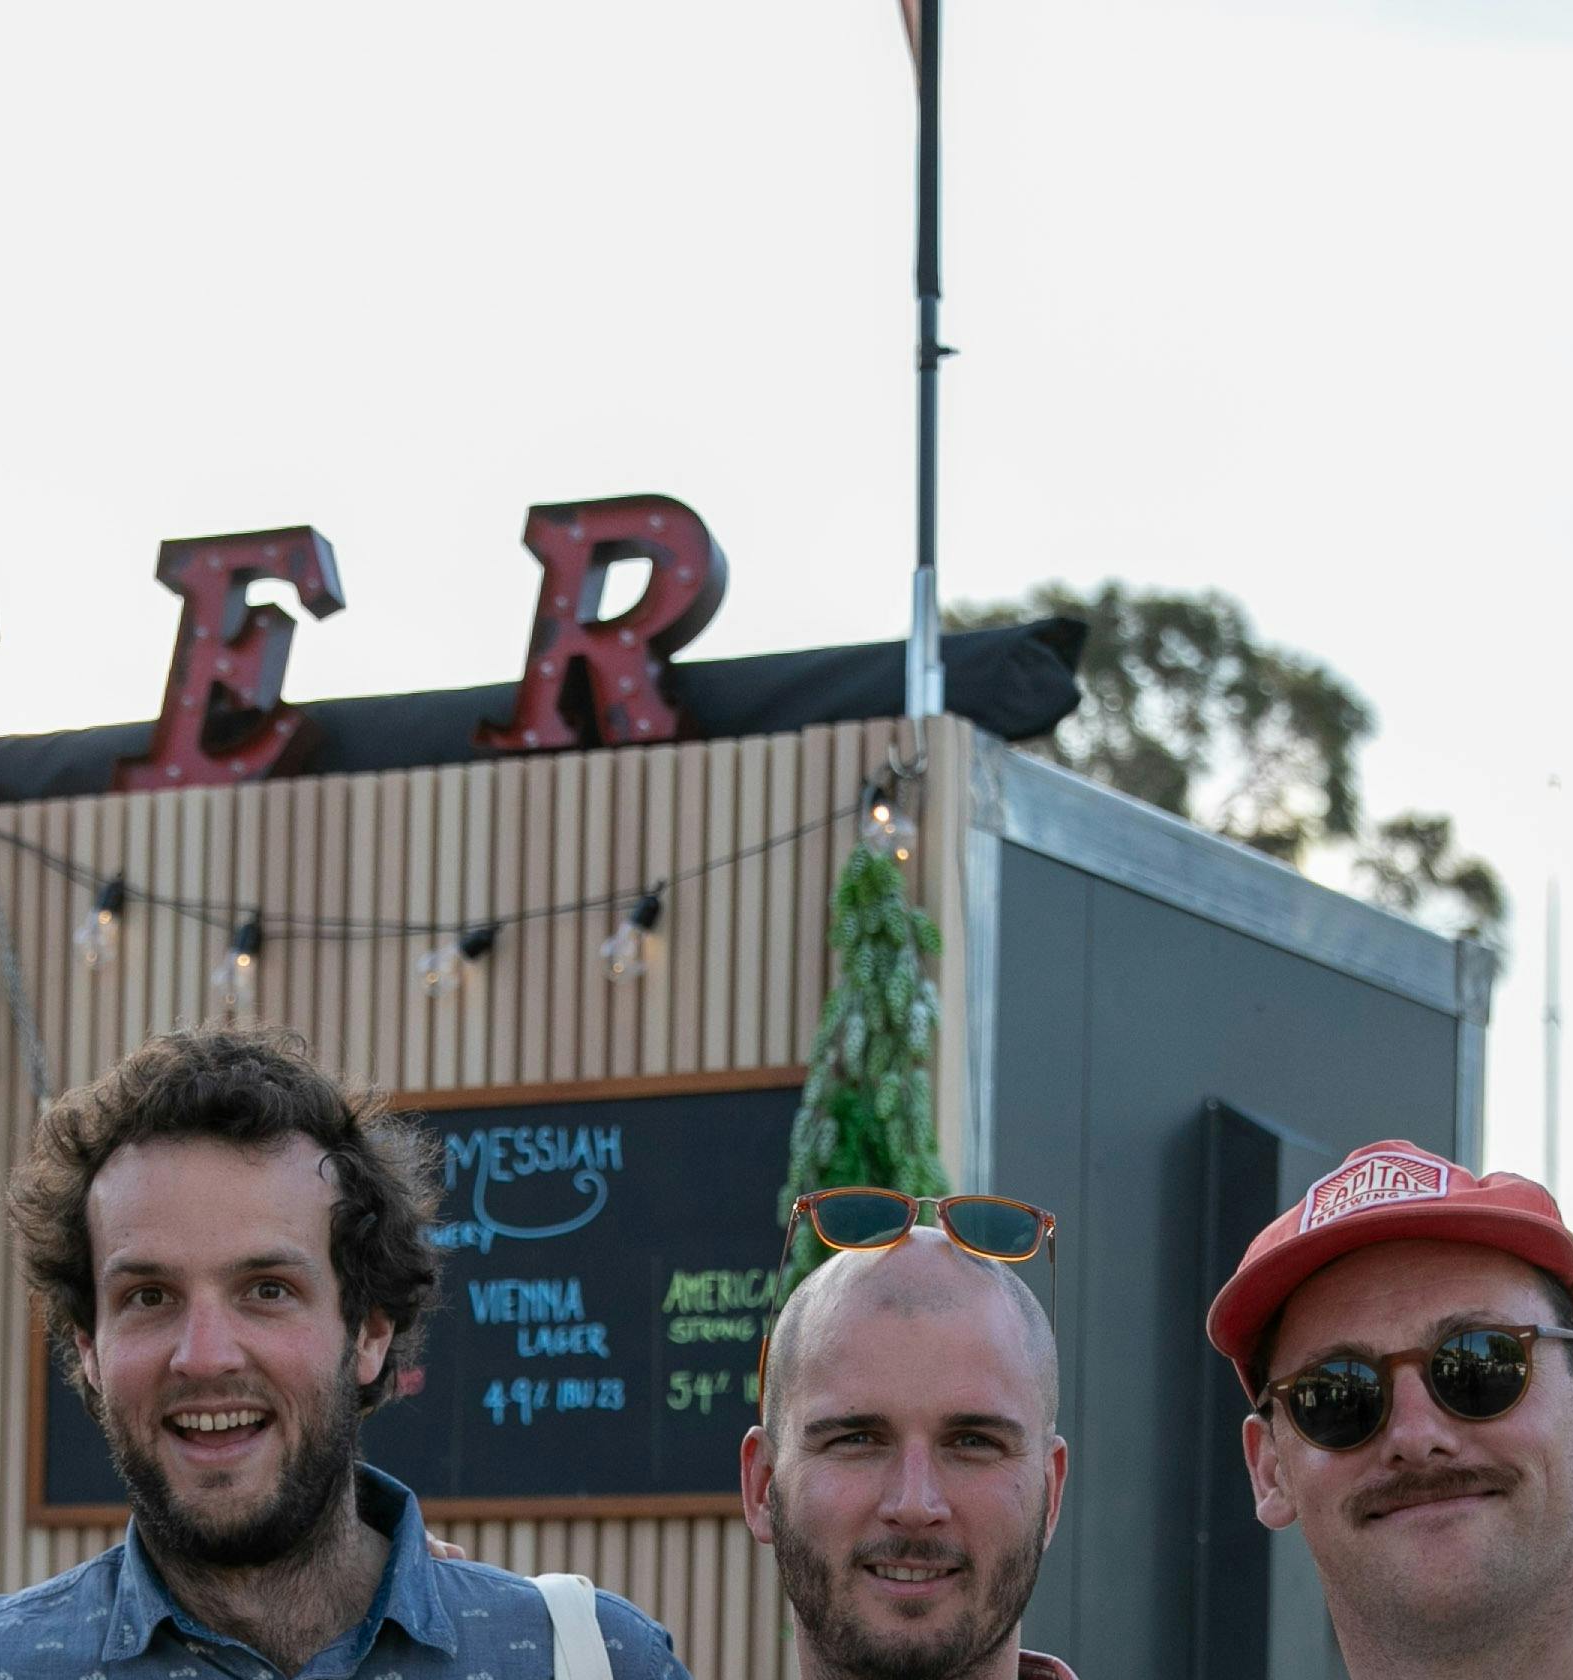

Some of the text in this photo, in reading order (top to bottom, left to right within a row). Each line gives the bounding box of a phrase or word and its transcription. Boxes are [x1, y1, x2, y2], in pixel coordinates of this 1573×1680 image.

[444, 1123, 624, 1220] MESSIAH
[1320, 1161, 1419, 1213] CAPITAL
[1316, 1192, 1400, 1225] BREWING
[468, 1276, 586, 1325] VIENNA
[516, 1321, 612, 1360] LAGER
[667, 1316, 757, 1344] STRONG
